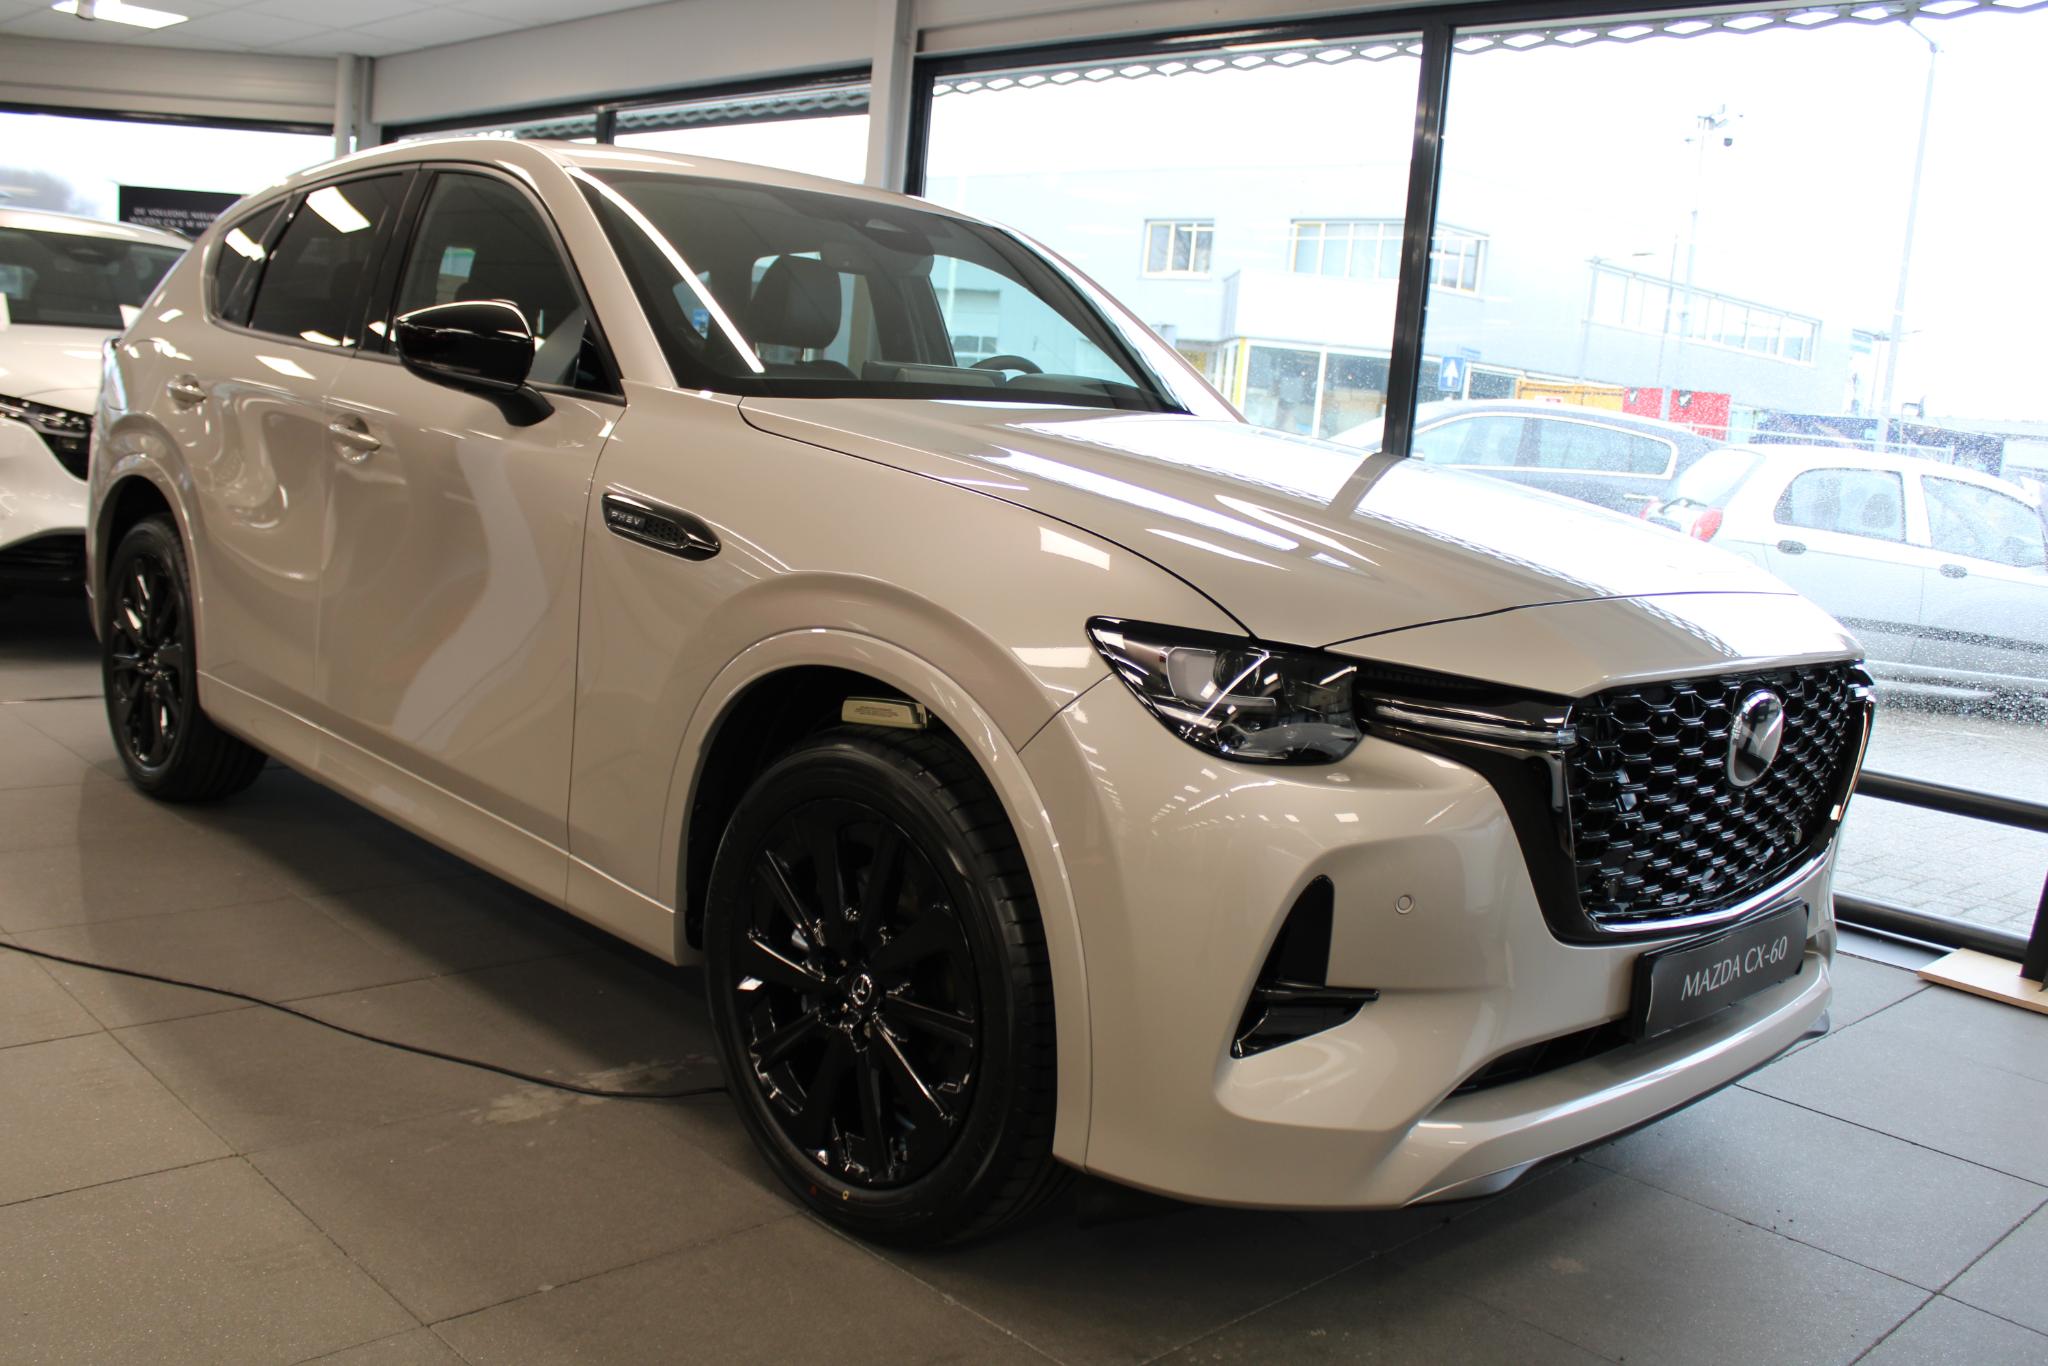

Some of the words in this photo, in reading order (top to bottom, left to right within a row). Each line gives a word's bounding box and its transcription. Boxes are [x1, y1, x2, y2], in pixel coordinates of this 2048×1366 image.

[611, 510, 640, 526] PHEV
[1681, 954, 1740, 1001] MAZDA
[1744, 935, 1788, 974] CX-60
